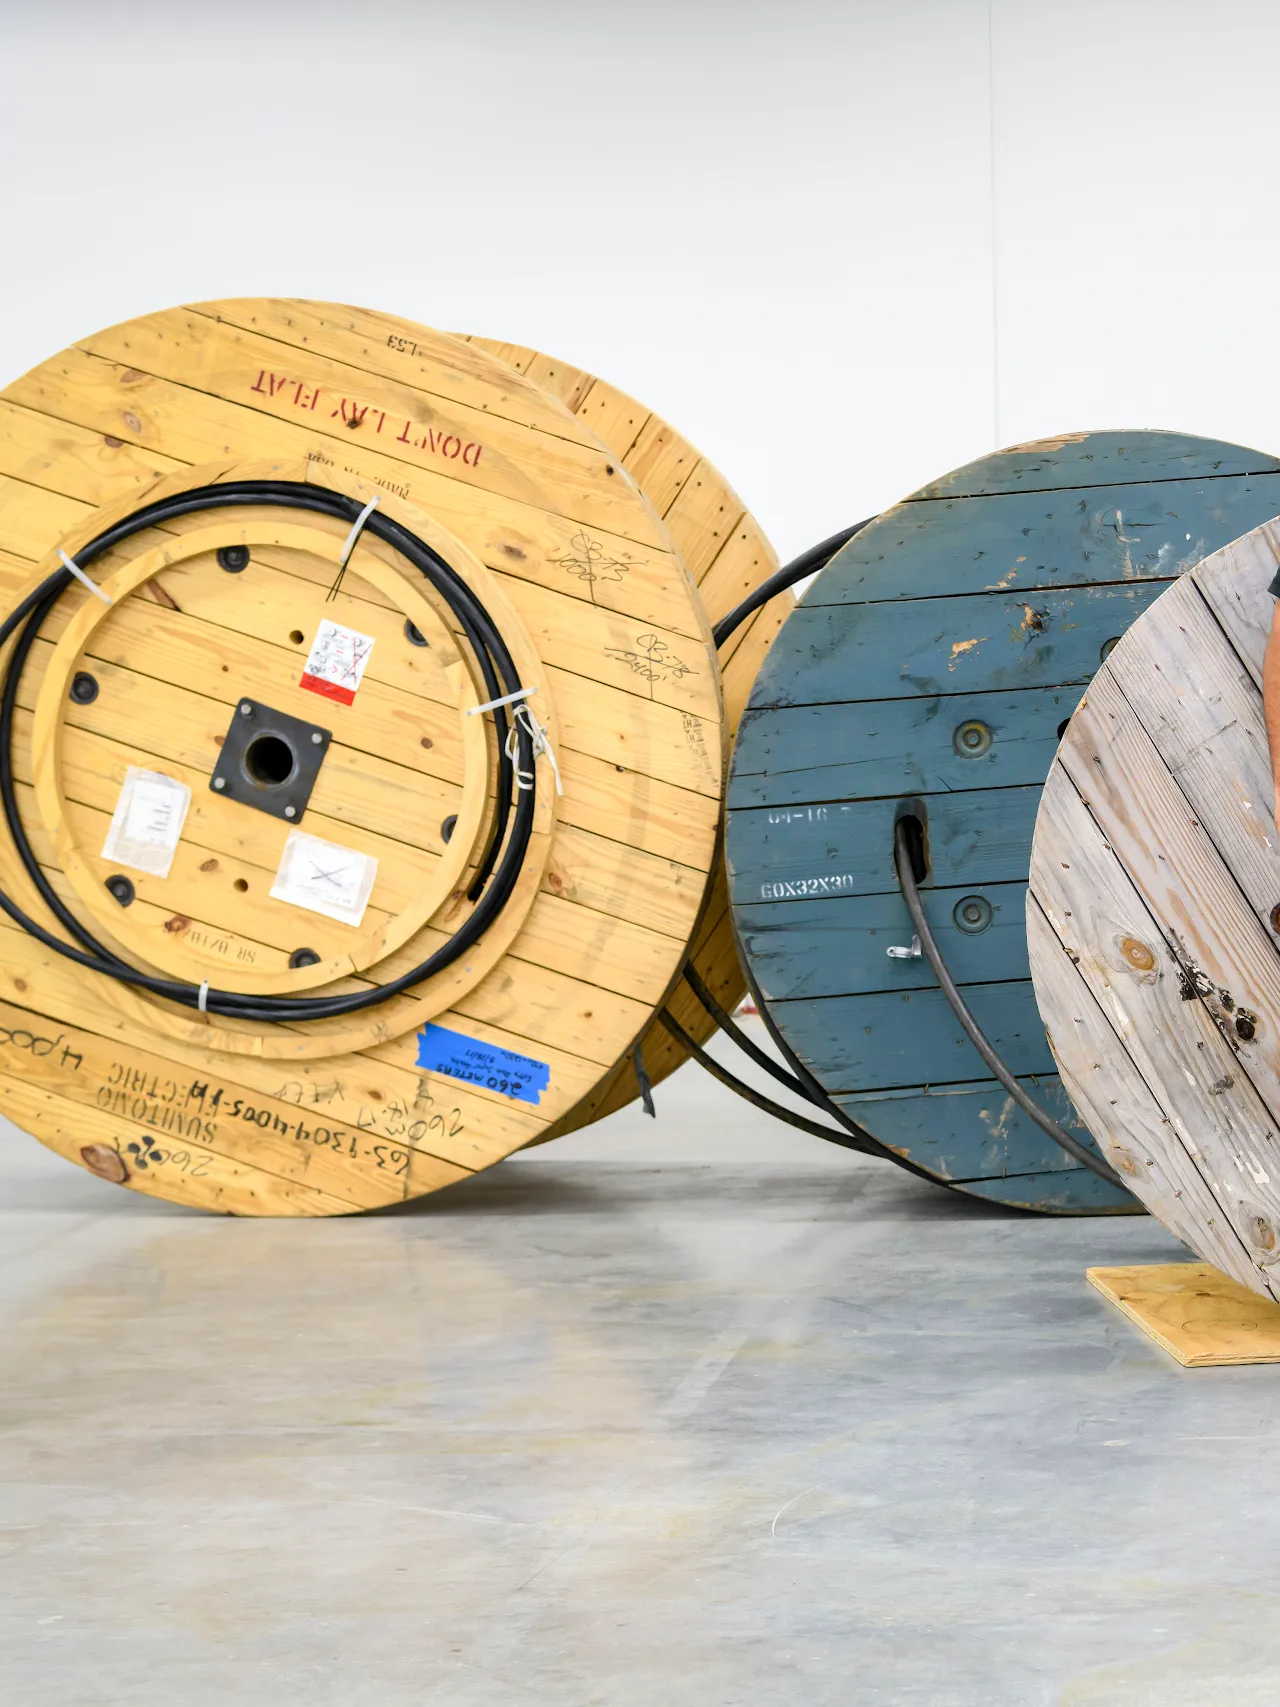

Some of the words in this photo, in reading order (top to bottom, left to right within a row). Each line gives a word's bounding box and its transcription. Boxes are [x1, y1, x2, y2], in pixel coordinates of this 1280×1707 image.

[386, 334, 417, 356] L53
[250, 370, 320, 411] FLAT
[331, 398, 386, 433] LAY
[396, 421, 482, 467] DON'T
[487, 1077, 522, 1096] 260
[96, 1086, 218, 1144] SUMITOMO
